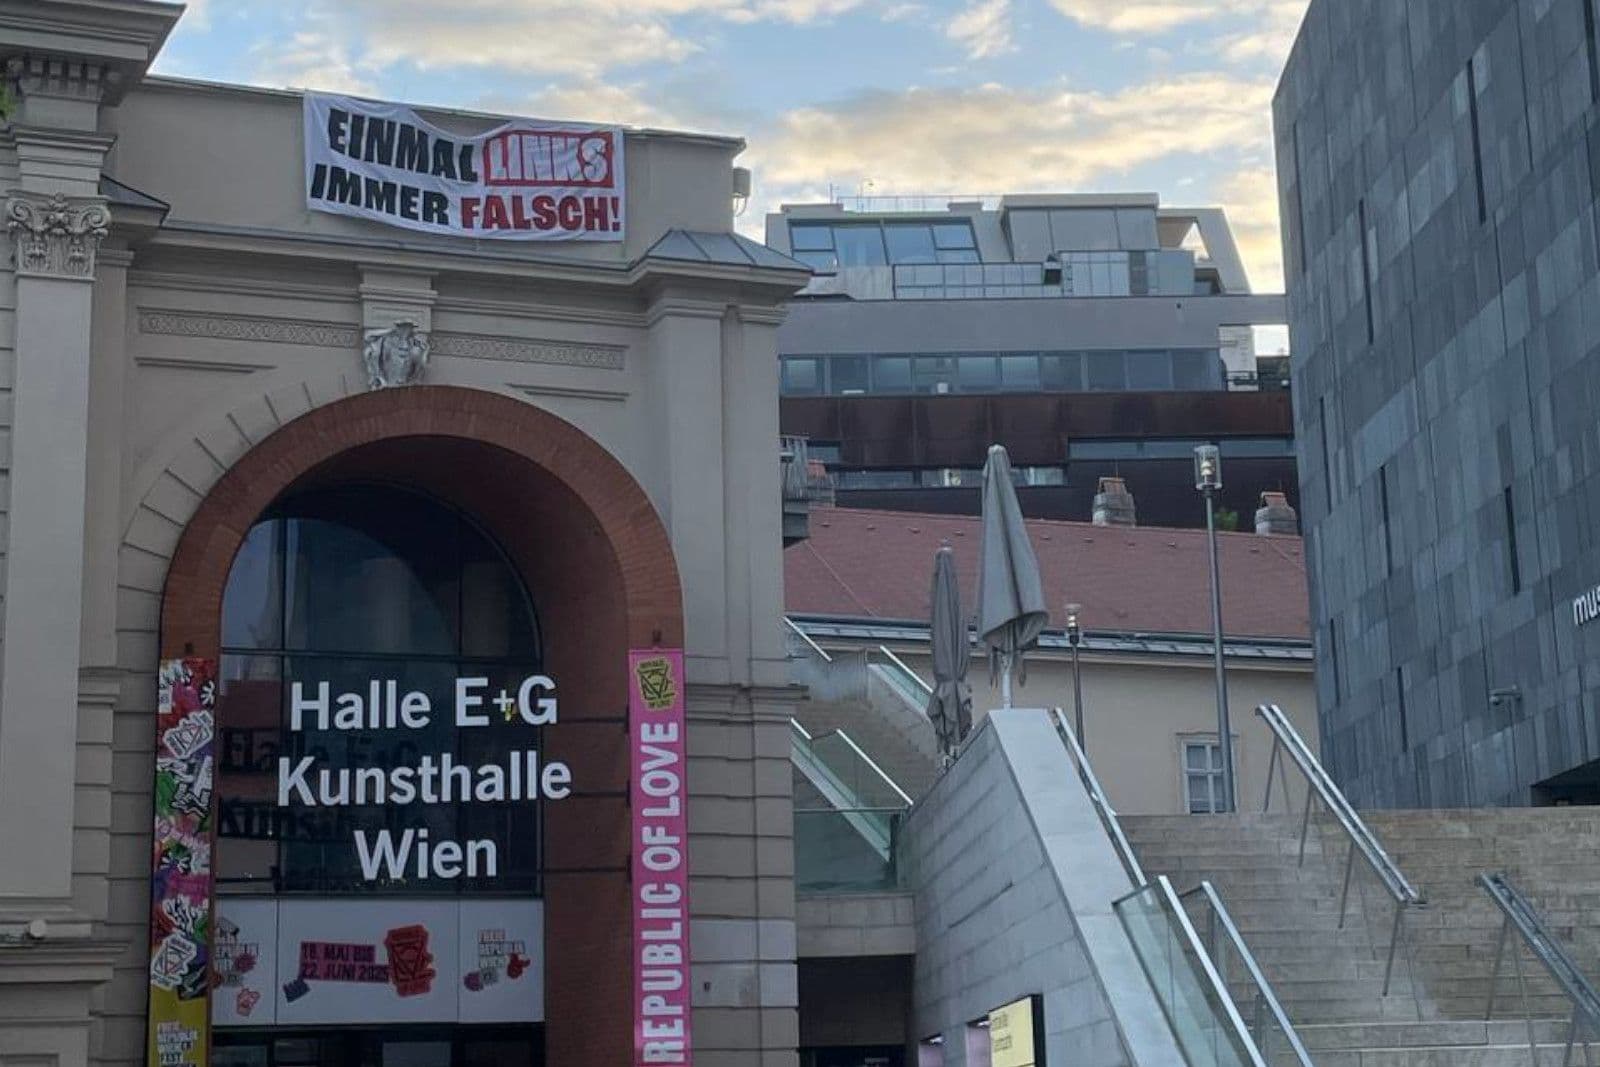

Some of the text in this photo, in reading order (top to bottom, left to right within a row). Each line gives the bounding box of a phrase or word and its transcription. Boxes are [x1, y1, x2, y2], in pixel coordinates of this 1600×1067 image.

[328, 108, 611, 184] EINMAL LINKS
[310, 163, 620, 232] IMMER FALSCH!
[290, 674, 558, 731] Halle E+G
[277, 750, 573, 807] Kunsthalle
[640, 721, 681, 817] LOVE
[353, 827, 498, 881] Wien
[640, 825, 681, 872] OF
[640, 883, 685, 1063] REPUBLIC
